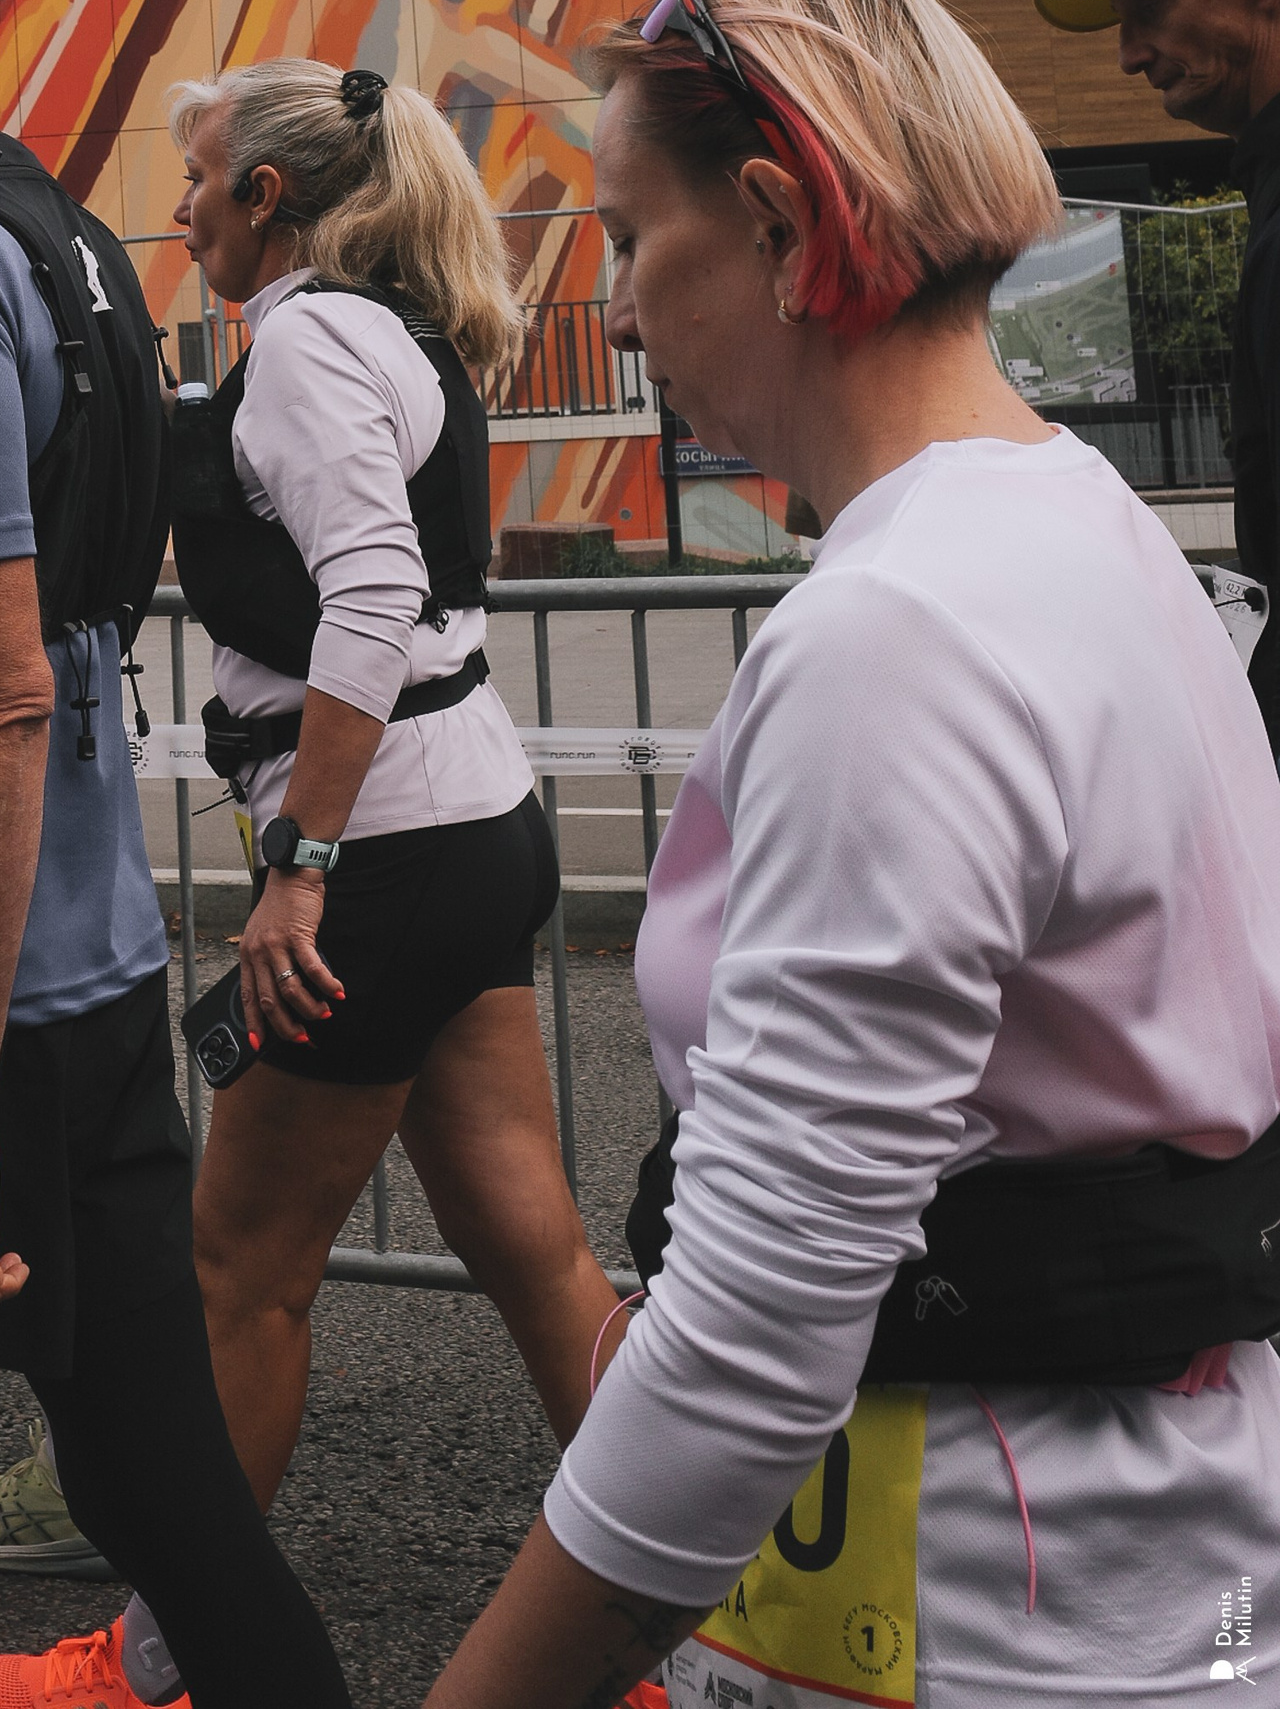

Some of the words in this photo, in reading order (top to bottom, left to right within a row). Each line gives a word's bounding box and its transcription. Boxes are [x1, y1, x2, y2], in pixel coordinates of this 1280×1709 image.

[549, 751, 596, 759] runc.run
[843, 1607, 858, 1631] БЕГУ
[861, 1625, 874, 1653] 1
[862, 1603, 903, 1671] МОСКОВСКИЙ
[842, 1636, 883, 1676] МАРАФОН
